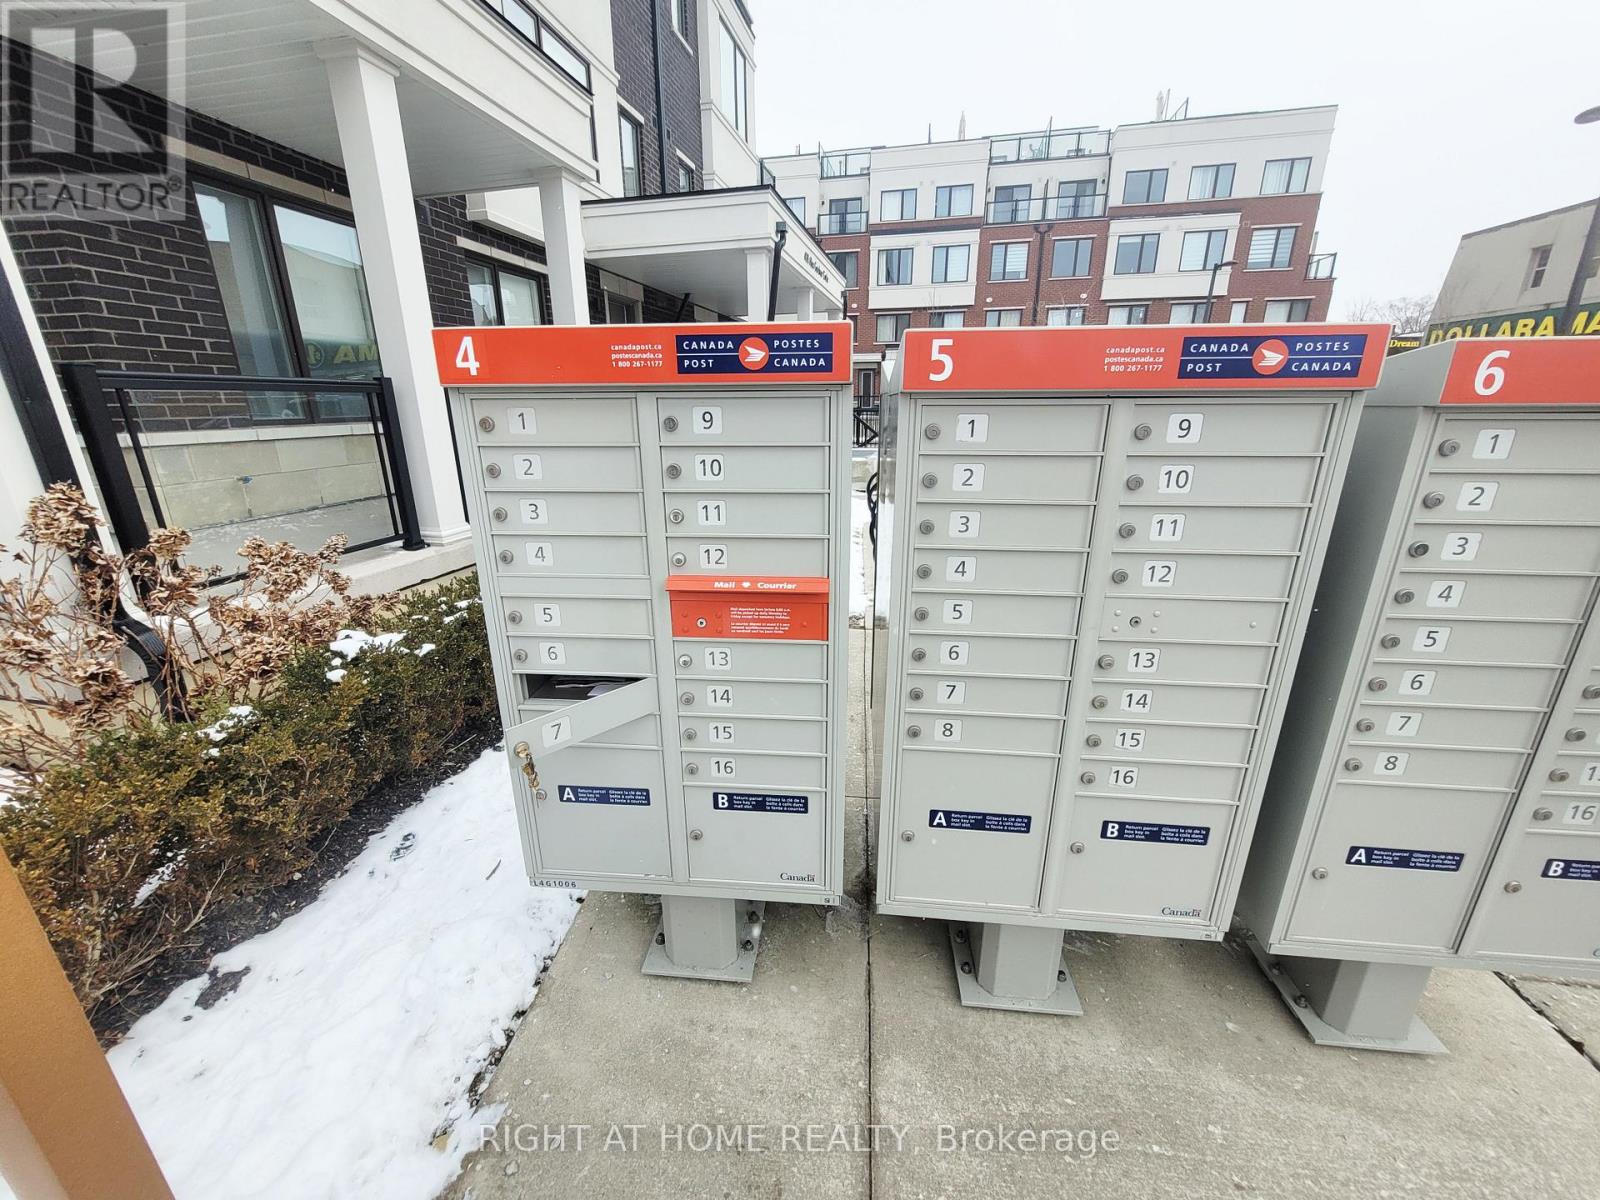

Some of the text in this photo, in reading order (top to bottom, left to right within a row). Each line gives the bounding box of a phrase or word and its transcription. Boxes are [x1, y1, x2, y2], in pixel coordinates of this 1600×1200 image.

[611, 344, 662, 352] canadapost.ca
[683, 340, 734, 350] CANADA
[773, 339, 820, 349] POSTES
[1105, 346, 1165, 355] canadapost.ca
[1190, 343, 1249, 353] CANADA
[1295, 341, 1350, 352] POSTES
[1389, 339, 1420, 348] Dream
[456, 336, 480, 376] 4
[611, 353, 663, 361] postescanada.ca
[632, 360, 663, 368] 267-1177
[684, 359, 714, 369] POST
[774, 358, 826, 368] CANADA
[928, 338, 954, 382] 5
[1104, 356, 1164, 364] postescanada.ca
[1127, 364, 1163, 372] 267-1177
[1186, 363, 1222, 373] POST
[1291, 361, 1352, 372] CANADA
[1473, 349, 1511, 396] 6
[517, 412, 526, 430] 1
[701, 410, 714, 430] 9
[967, 419, 975, 438] 1
[1177, 418, 1192, 439] 9
[1490, 433, 1500, 454] 1
[522, 458, 534, 476] 2
[699, 458, 722, 477] 10
[961, 468, 974, 487] 2
[1164, 469, 1190, 489] 10
[1467, 486, 1485, 506] 2
[528, 503, 540, 520] 3
[701, 504, 721, 522] 11
[957, 515, 970, 534] 3
[1156, 518, 1178, 537] 11
[534, 546, 546, 562] 4
[1452, 536, 1469, 556] 3
[704, 548, 725, 565] 12
[954, 560, 967, 577] 4
[1148, 565, 1172, 583] 12
[714, 581, 735, 589] Mail
[757, 582, 797, 590] Courrier
[1437, 584, 1453, 602] 4
[542, 607, 553, 623] 5
[952, 603, 963, 620] 5
[1423, 630, 1440, 648] 5
[547, 645, 558, 661] 6
[708, 651, 729, 667] 13
[948, 644, 960, 661] 6
[1132, 652, 1156, 669] 13
[1410, 674, 1425, 691] 6
[711, 688, 732, 704] 14
[945, 684, 957, 700] 7
[1126, 692, 1148, 709] 14
[942, 722, 954, 738] 8
[1398, 715, 1412, 731] 7
[550, 722, 562, 741] 7
[713, 725, 732, 740] 15
[1119, 732, 1142, 748] 15
[714, 760, 734, 775] 16
[1383, 755, 1398, 771] 8
[1113, 769, 1135, 785] 16
[563, 787, 576, 801] A
[718, 794, 728, 808] B
[933, 812, 947, 826] A
[1571, 804, 1595, 821] 16
[1106, 823, 1119, 838] B
[1350, 848, 1366, 863] A
[1548, 861, 1565, 876] B
[533, 879, 577, 888] L4G1006
[780, 872, 816, 882] Canada
[1161, 906, 1202, 917] Canada
